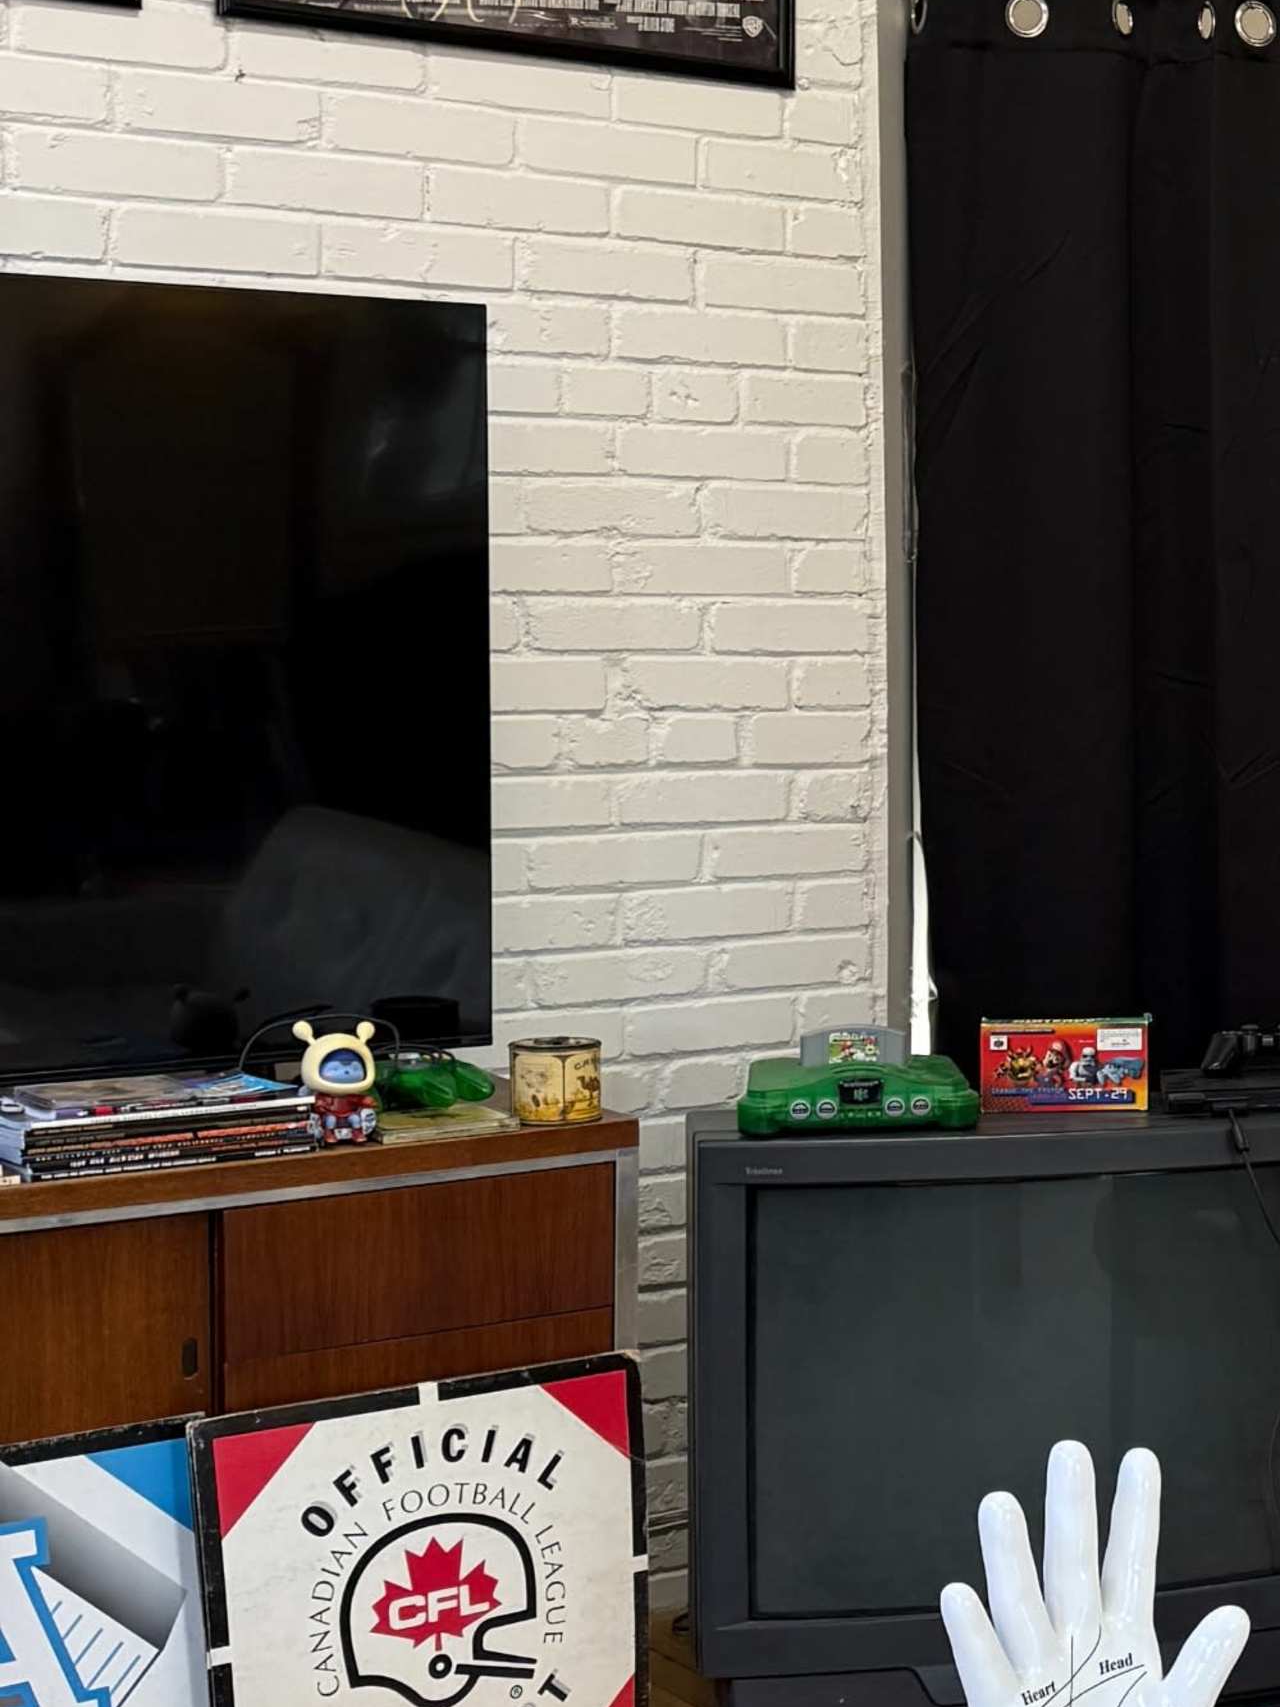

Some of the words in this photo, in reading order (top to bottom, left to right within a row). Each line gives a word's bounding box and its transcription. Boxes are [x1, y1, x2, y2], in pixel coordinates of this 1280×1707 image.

[299, 1421, 567, 1540] OFFICIAL
[304, 1522, 369, 1698] CANADIAN
[382, 1481, 538, 1527] FOOTBALL
[534, 1523, 568, 1646] LEAGUE
[387, 1581, 490, 1632] CFL
[1098, 1653, 1134, 1676] Head
[1022, 1680, 1057, 1706] Heart
